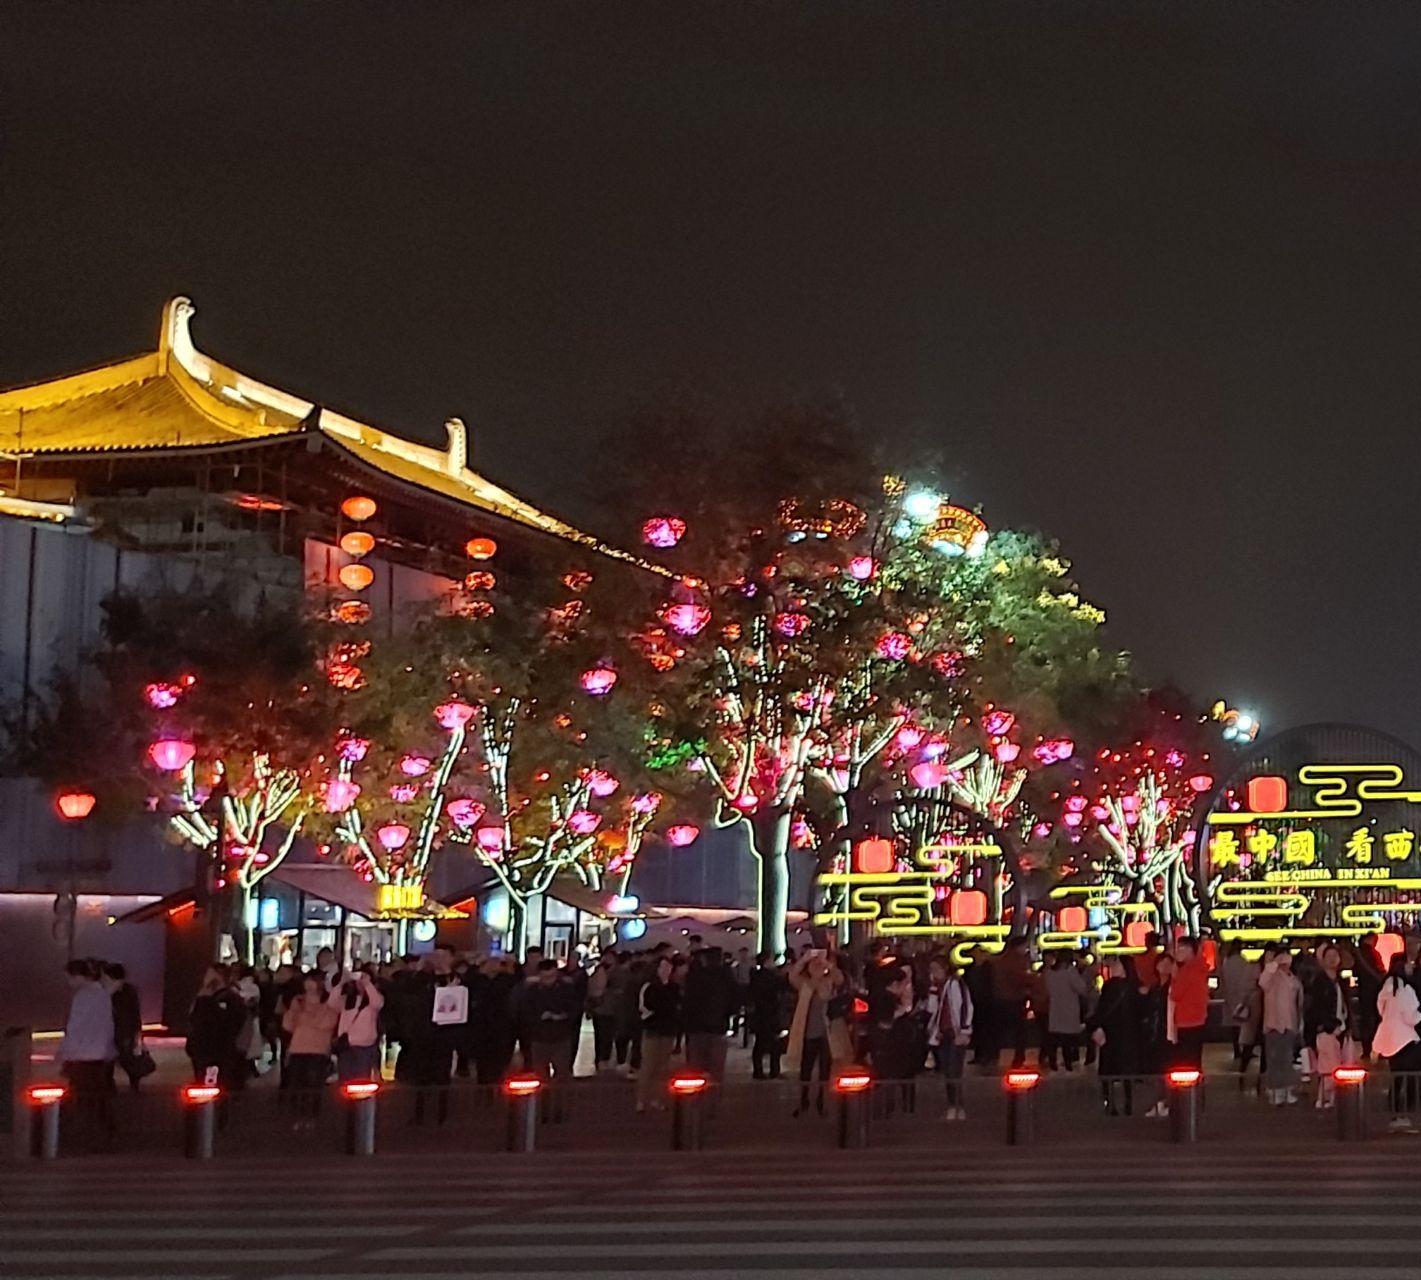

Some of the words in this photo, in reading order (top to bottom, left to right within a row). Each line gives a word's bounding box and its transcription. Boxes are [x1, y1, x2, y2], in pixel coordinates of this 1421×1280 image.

[1210, 830, 1315, 868] 最中國
[1291, 868, 1332, 880] CHINA
[1337, 868, 1354, 879] IN
